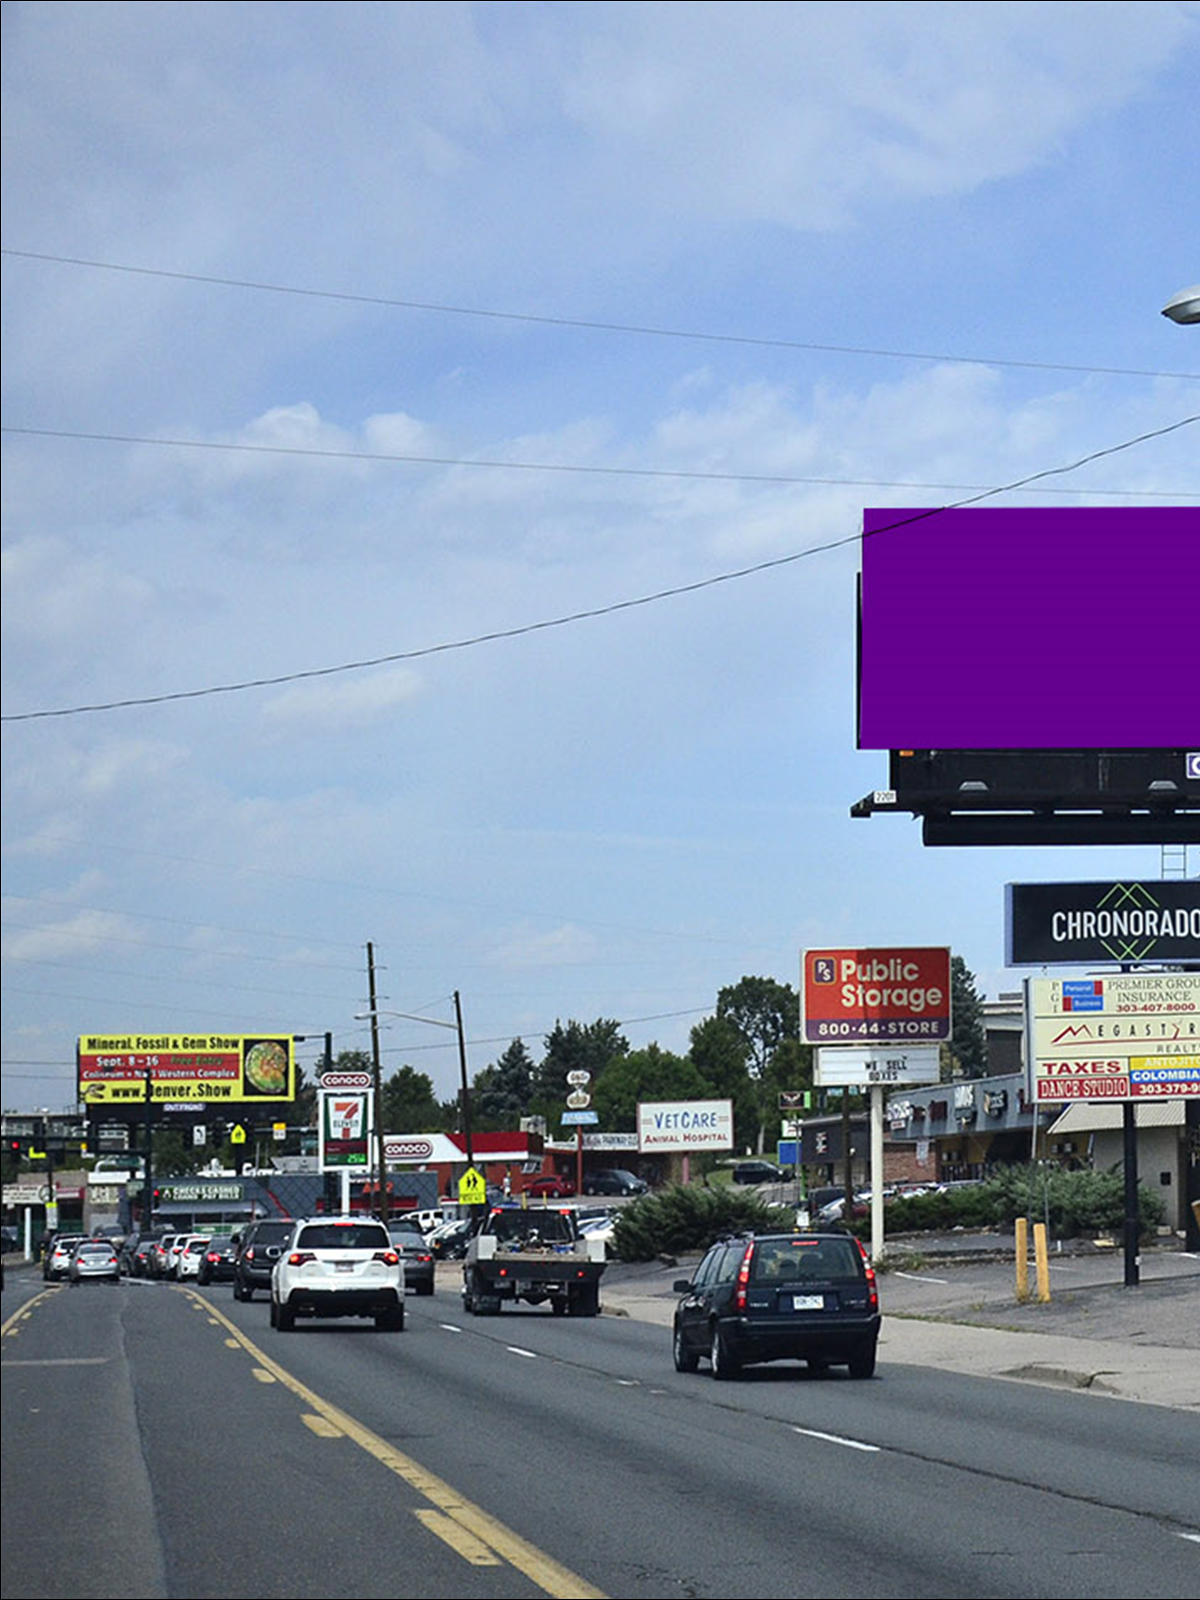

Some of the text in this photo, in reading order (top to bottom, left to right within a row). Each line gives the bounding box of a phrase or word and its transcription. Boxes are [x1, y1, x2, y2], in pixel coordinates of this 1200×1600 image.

[840, 958, 920, 982] Public
[1108, 978, 1162, 991] PREMIER
[841, 983, 943, 1012] Storage
[1117, 991, 1192, 1003] INSURANCE
[1074, 1000, 1101, 1008] Business
[1116, 1003, 1196, 1013] 303-407-8000
[136, 1038, 169, 1050] Fossil
[172, 1040, 179, 1049] &
[182, 1038, 207, 1049] Gem
[209, 1037, 239, 1049] Show
[96, 1056, 125, 1067] Sept.
[886, 1060, 908, 1070] SELL
[1042, 1061, 1122, 1075] TAXES
[158, 1070, 195, 1078] Western
[197, 1070, 236, 1079] Complex
[1041, 1078, 1127, 1098] DANCE STUDIO
[644, 1134, 680, 1144] ANIMAL
[682, 1133, 728, 1143] HOSPITAL
